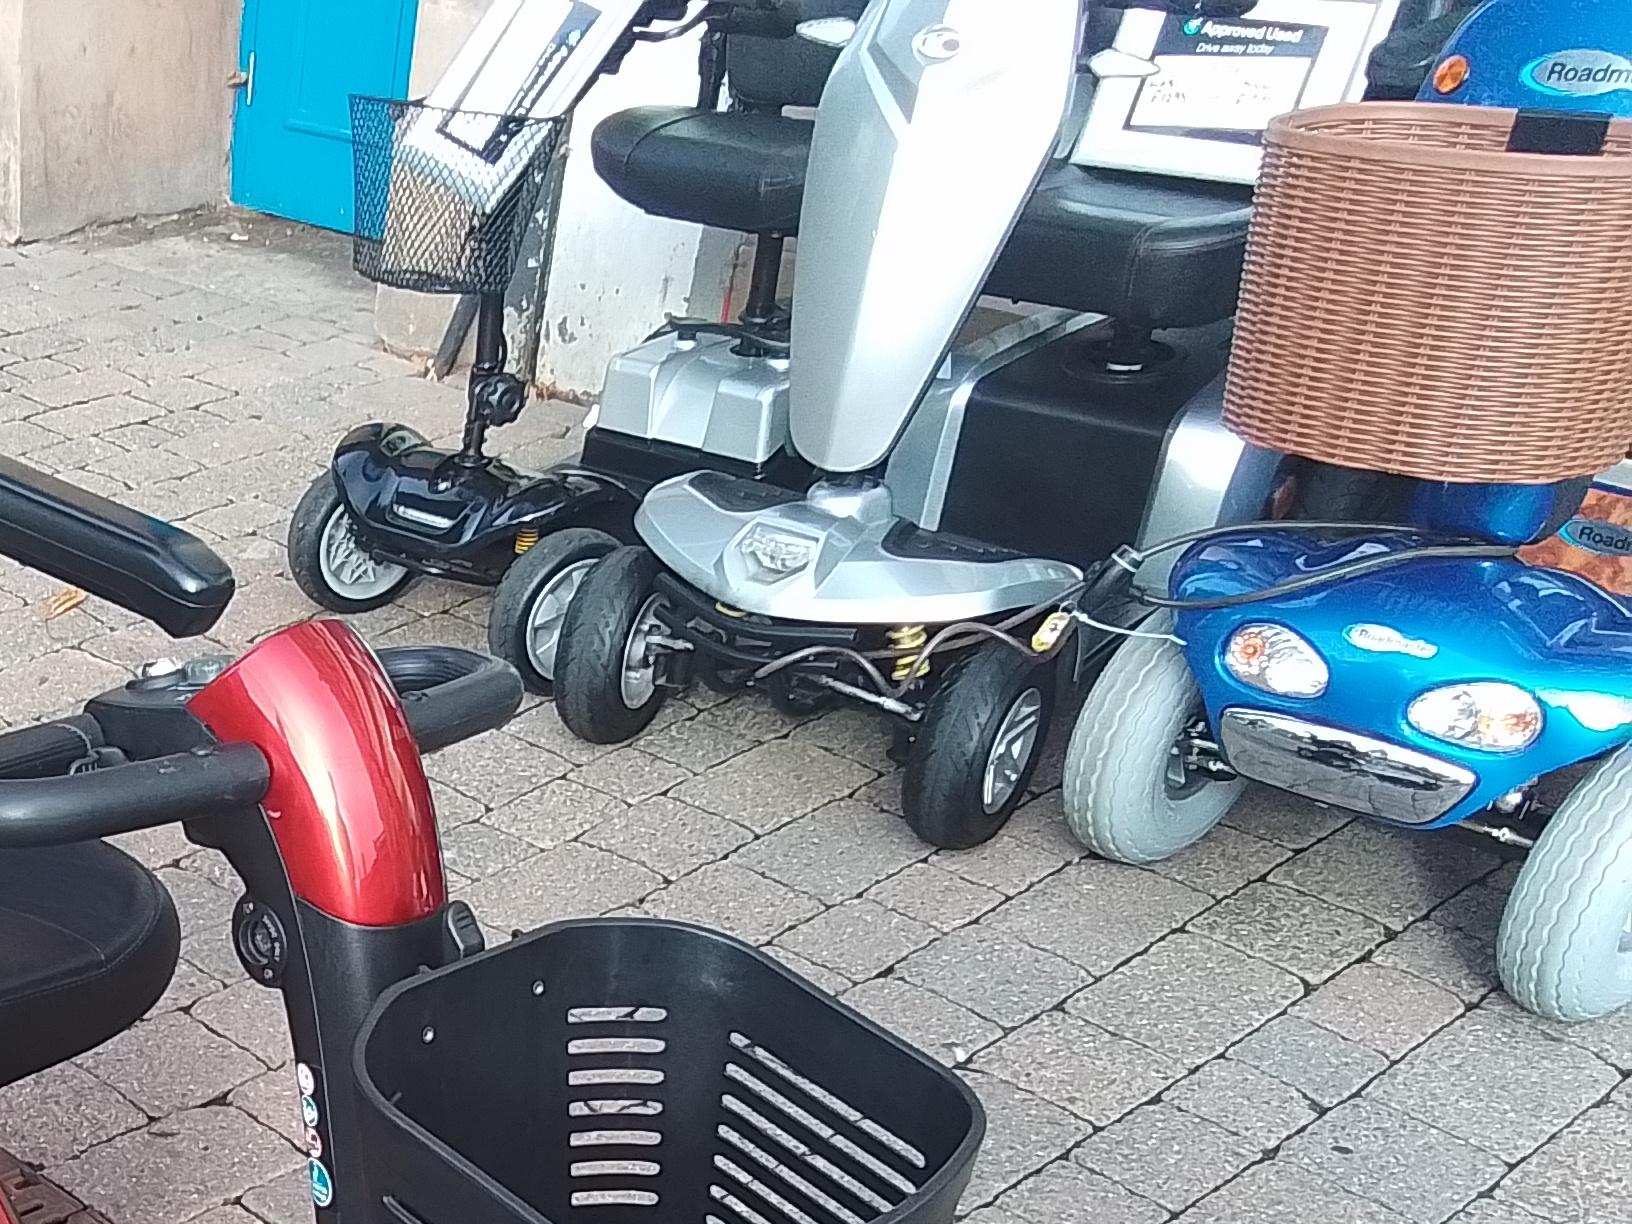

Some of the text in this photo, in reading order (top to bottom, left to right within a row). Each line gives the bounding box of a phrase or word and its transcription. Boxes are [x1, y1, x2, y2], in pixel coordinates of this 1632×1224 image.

[1201, 21, 1304, 43] Approved Used
[1196, 43, 1220, 53] Drive
[1246, 44, 1275, 55] today
